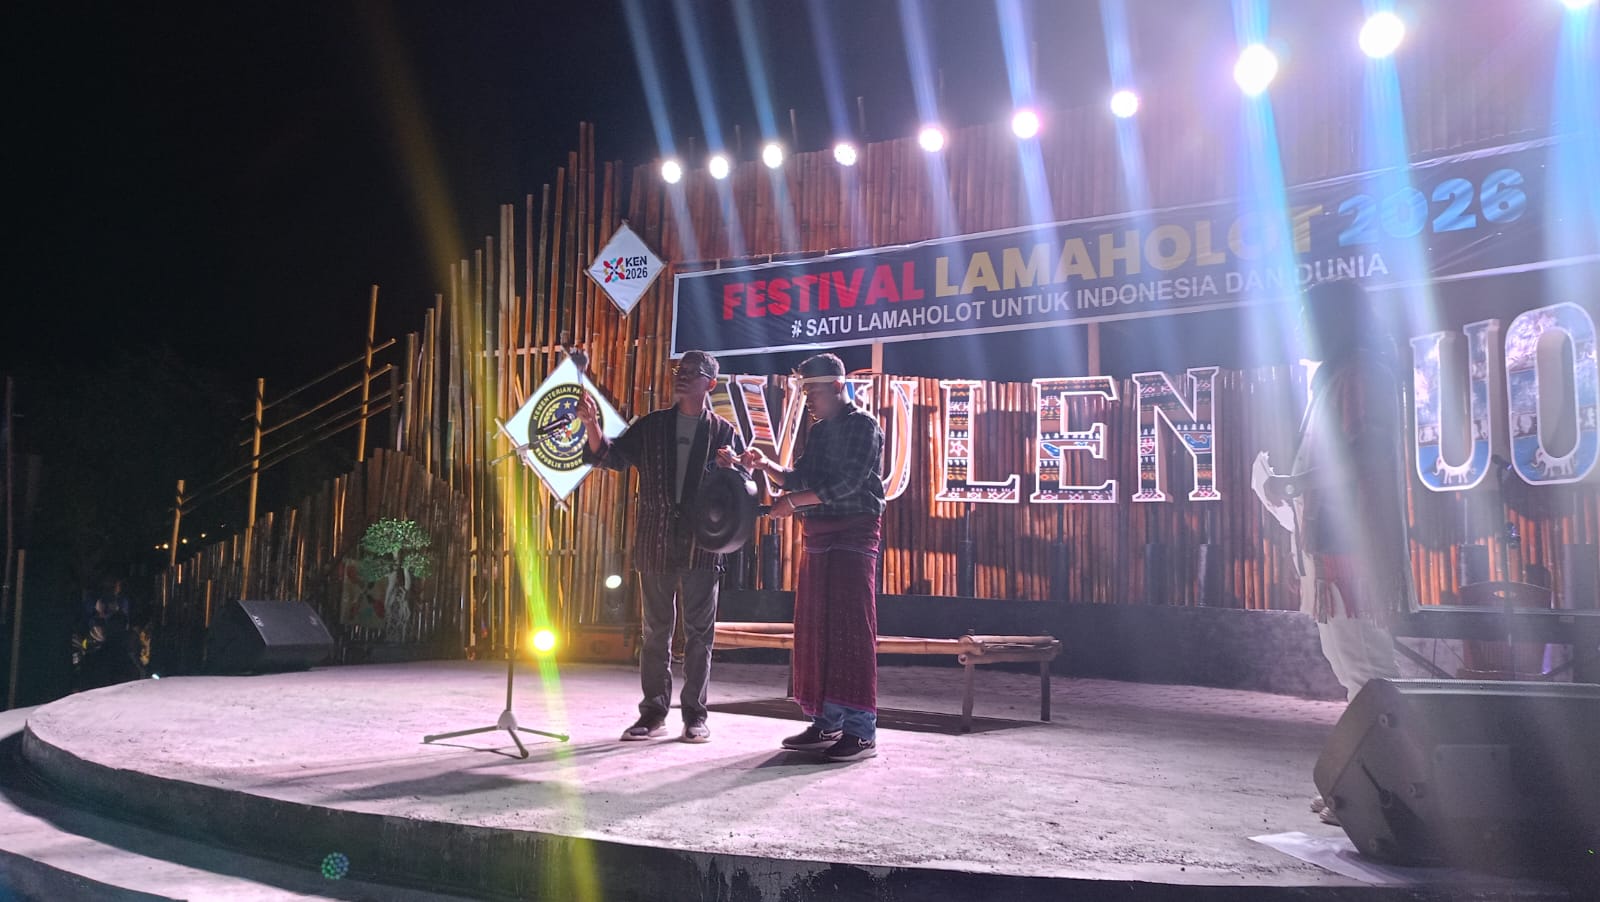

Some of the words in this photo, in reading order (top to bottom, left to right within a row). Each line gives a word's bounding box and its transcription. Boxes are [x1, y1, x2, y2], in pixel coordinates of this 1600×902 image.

[723, 261, 925, 321] FESTIVAL
[935, 204, 1324, 298] LAMAHOLOT
[1338, 168, 1528, 247] 2026
[625, 255, 648, 267] KEN
[625, 267, 648, 280] 2026
[806, 315, 852, 337] SATU
[858, 300, 986, 332] LAMAHOLOT
[992, 293, 1070, 318] UNTUK
[1077, 270, 1218, 309] INDONESIA
[1226, 267, 1284, 295] DAN
[1296, 252, 1389, 286] DUNIA
[533, 386, 571, 421] KEMENTERIAN
[535, 447, 561, 469] REPUBLIK
[563, 458, 583, 469] INDON
